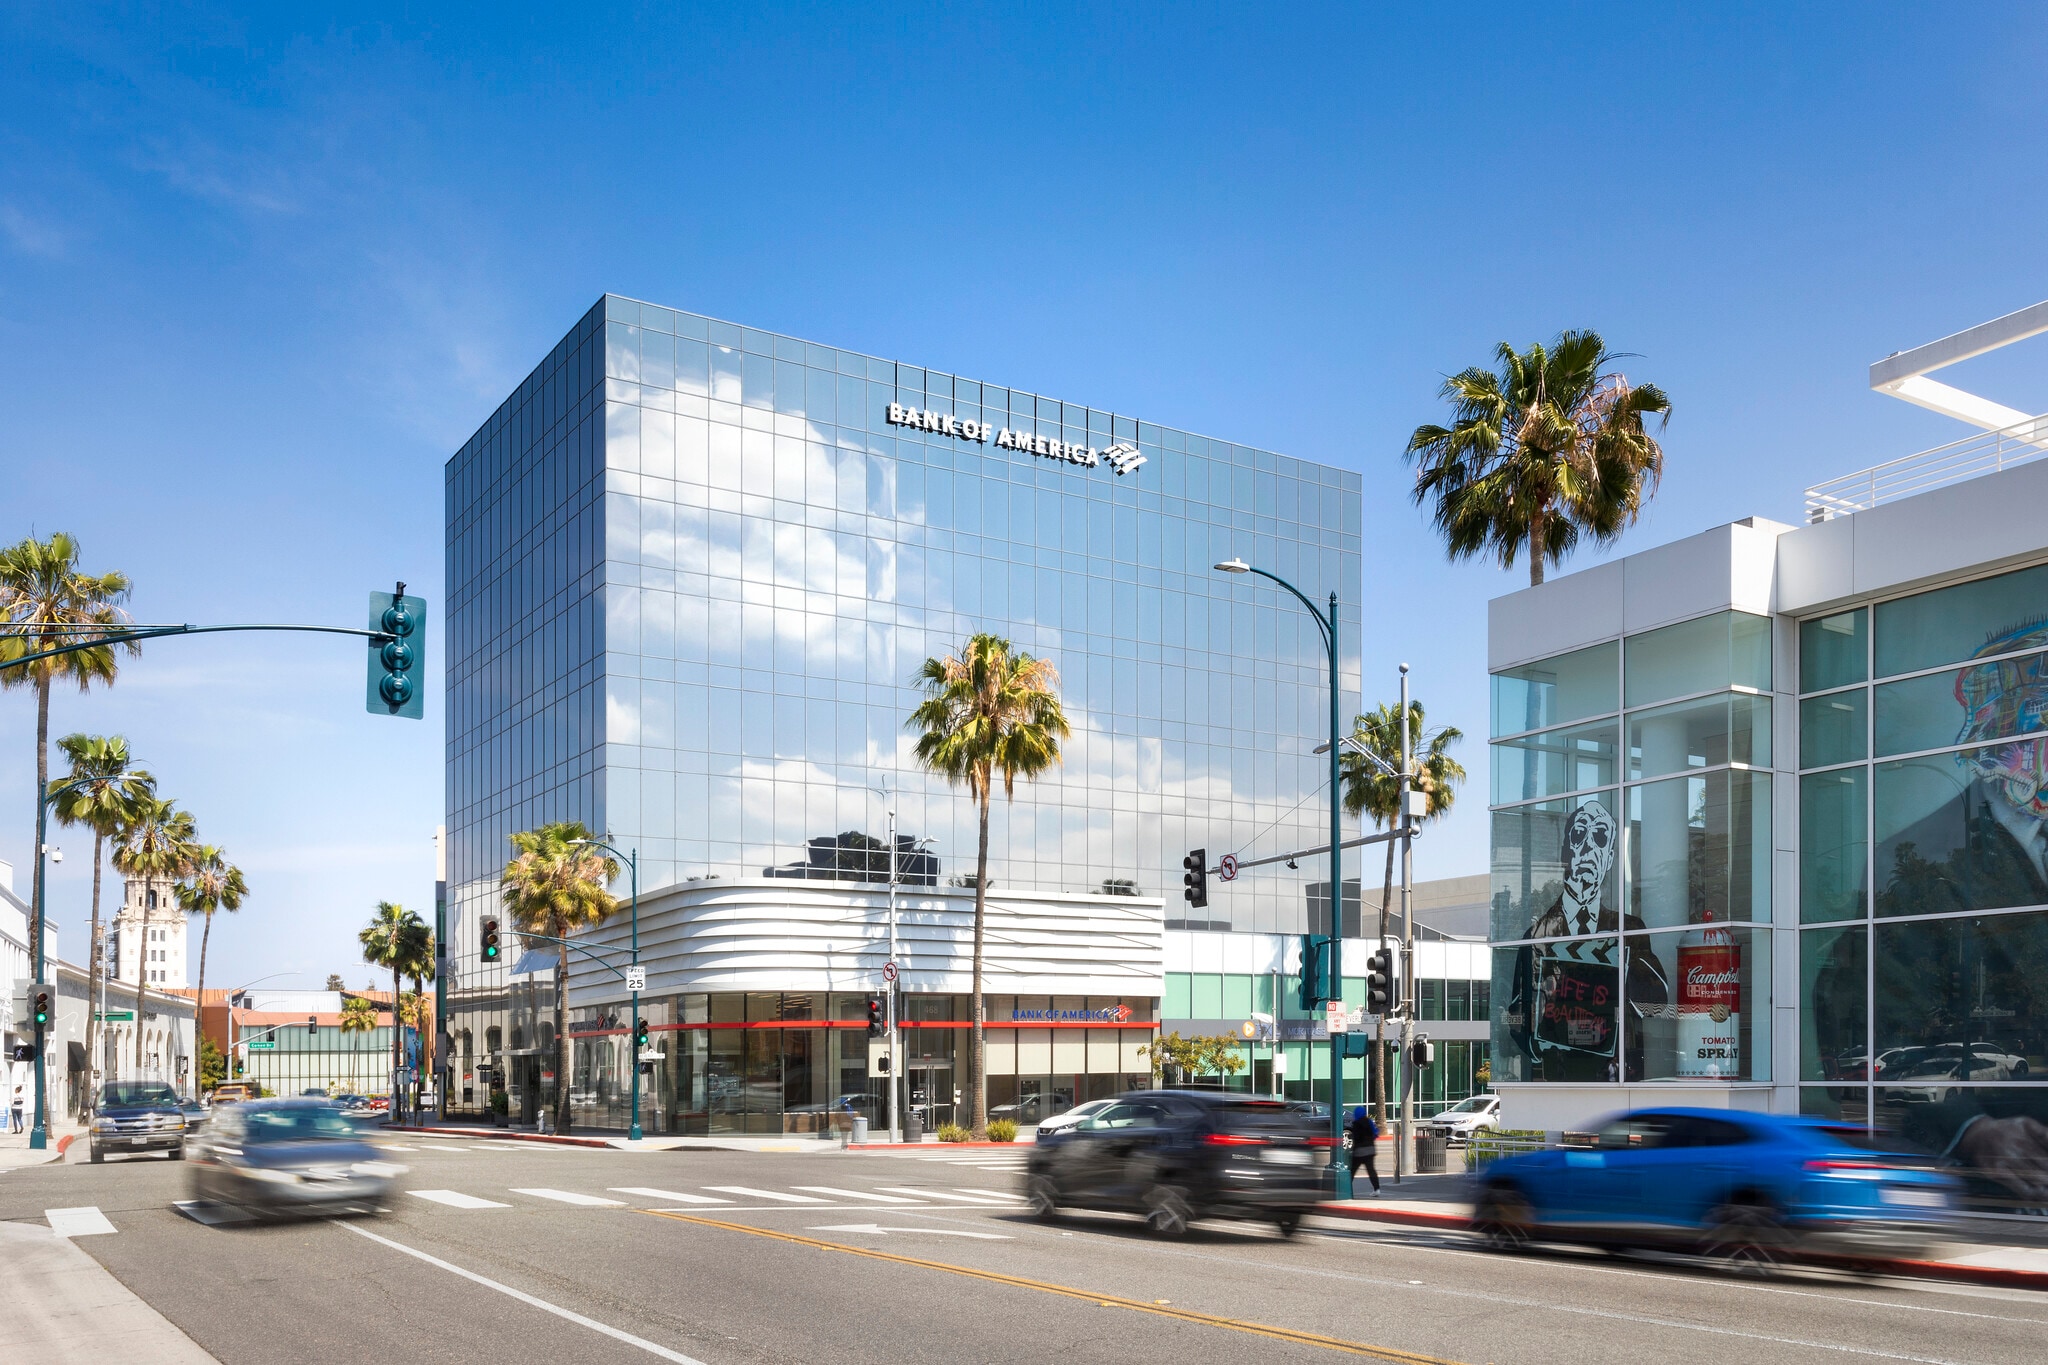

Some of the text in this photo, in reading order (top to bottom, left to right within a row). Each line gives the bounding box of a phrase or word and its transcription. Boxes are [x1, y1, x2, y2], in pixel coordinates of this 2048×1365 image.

[888, 402, 1100, 466] BANK OF AMERICA
[629, 980, 644, 988] 25
[1592, 984, 1609, 1006] IS
[1012, 1009, 1109, 1019] BANK OF AMERICA
[1698, 1048, 1738, 1059] SPRAY
